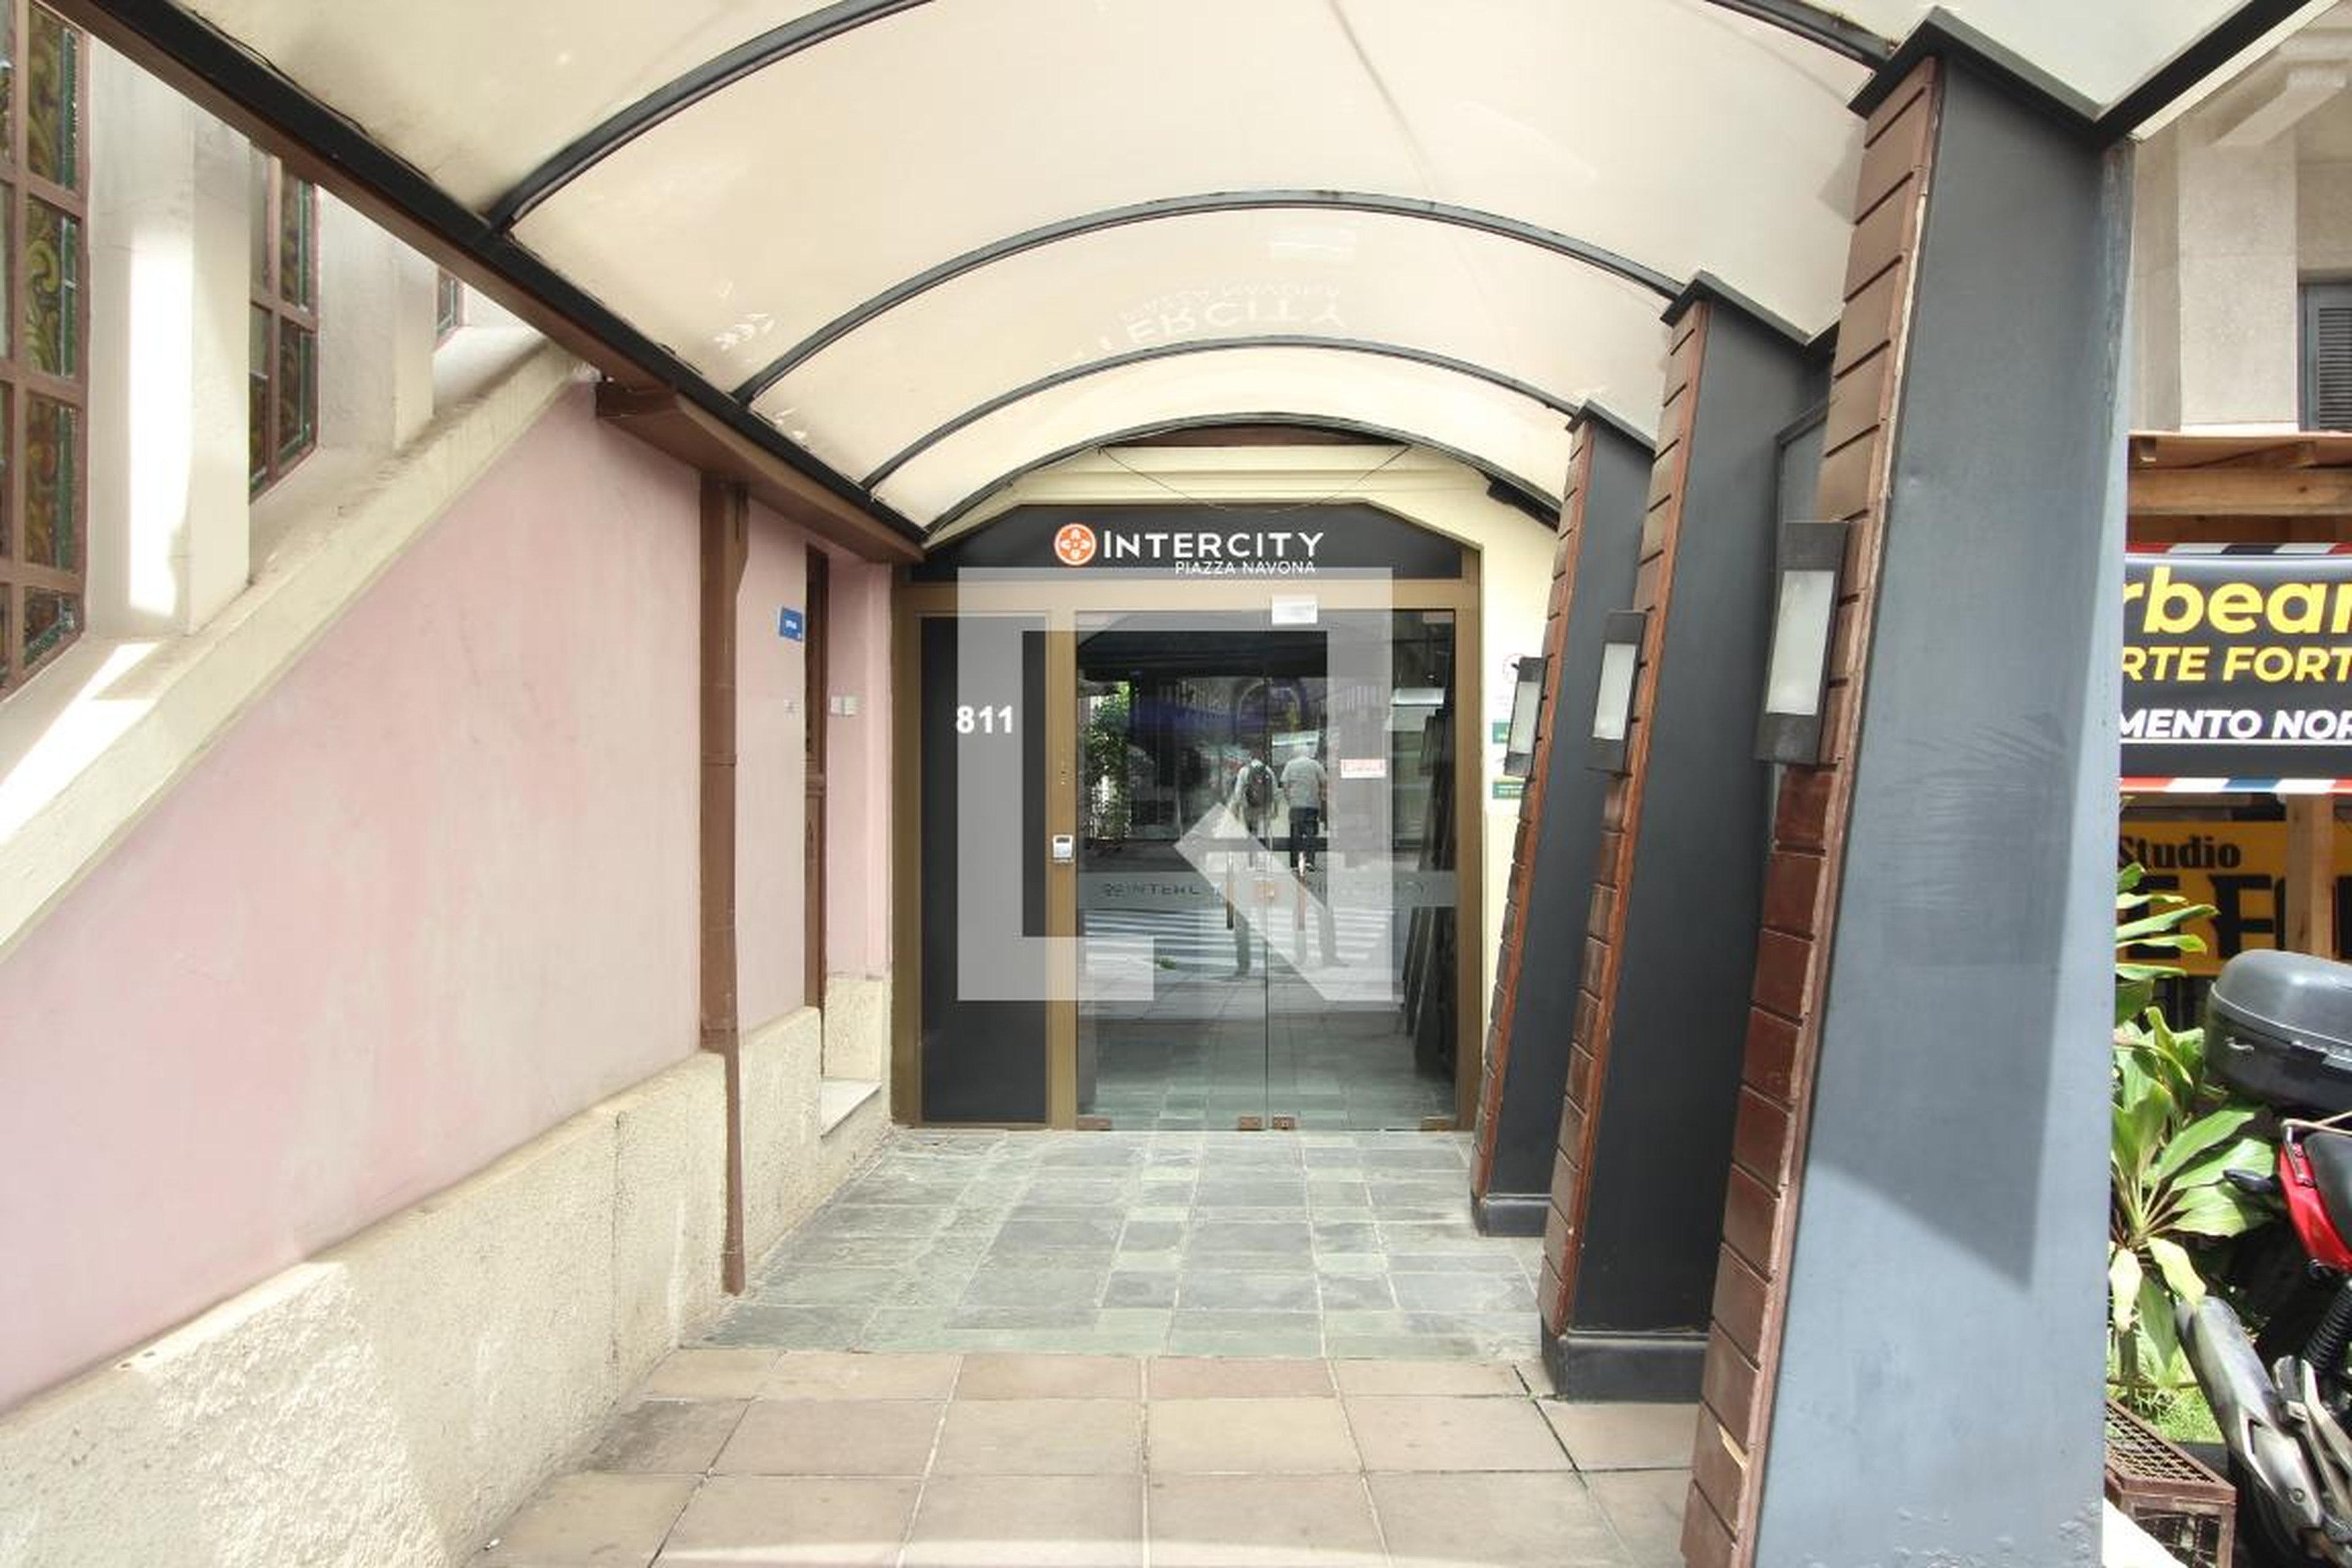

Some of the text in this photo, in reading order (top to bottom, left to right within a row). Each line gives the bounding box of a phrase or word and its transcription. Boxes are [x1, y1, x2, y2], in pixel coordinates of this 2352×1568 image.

[1104, 530, 1324, 558] INTERCITY
[1175, 561, 1316, 575] PIAZZA NAVONA
[957, 706, 1012, 733] 811
